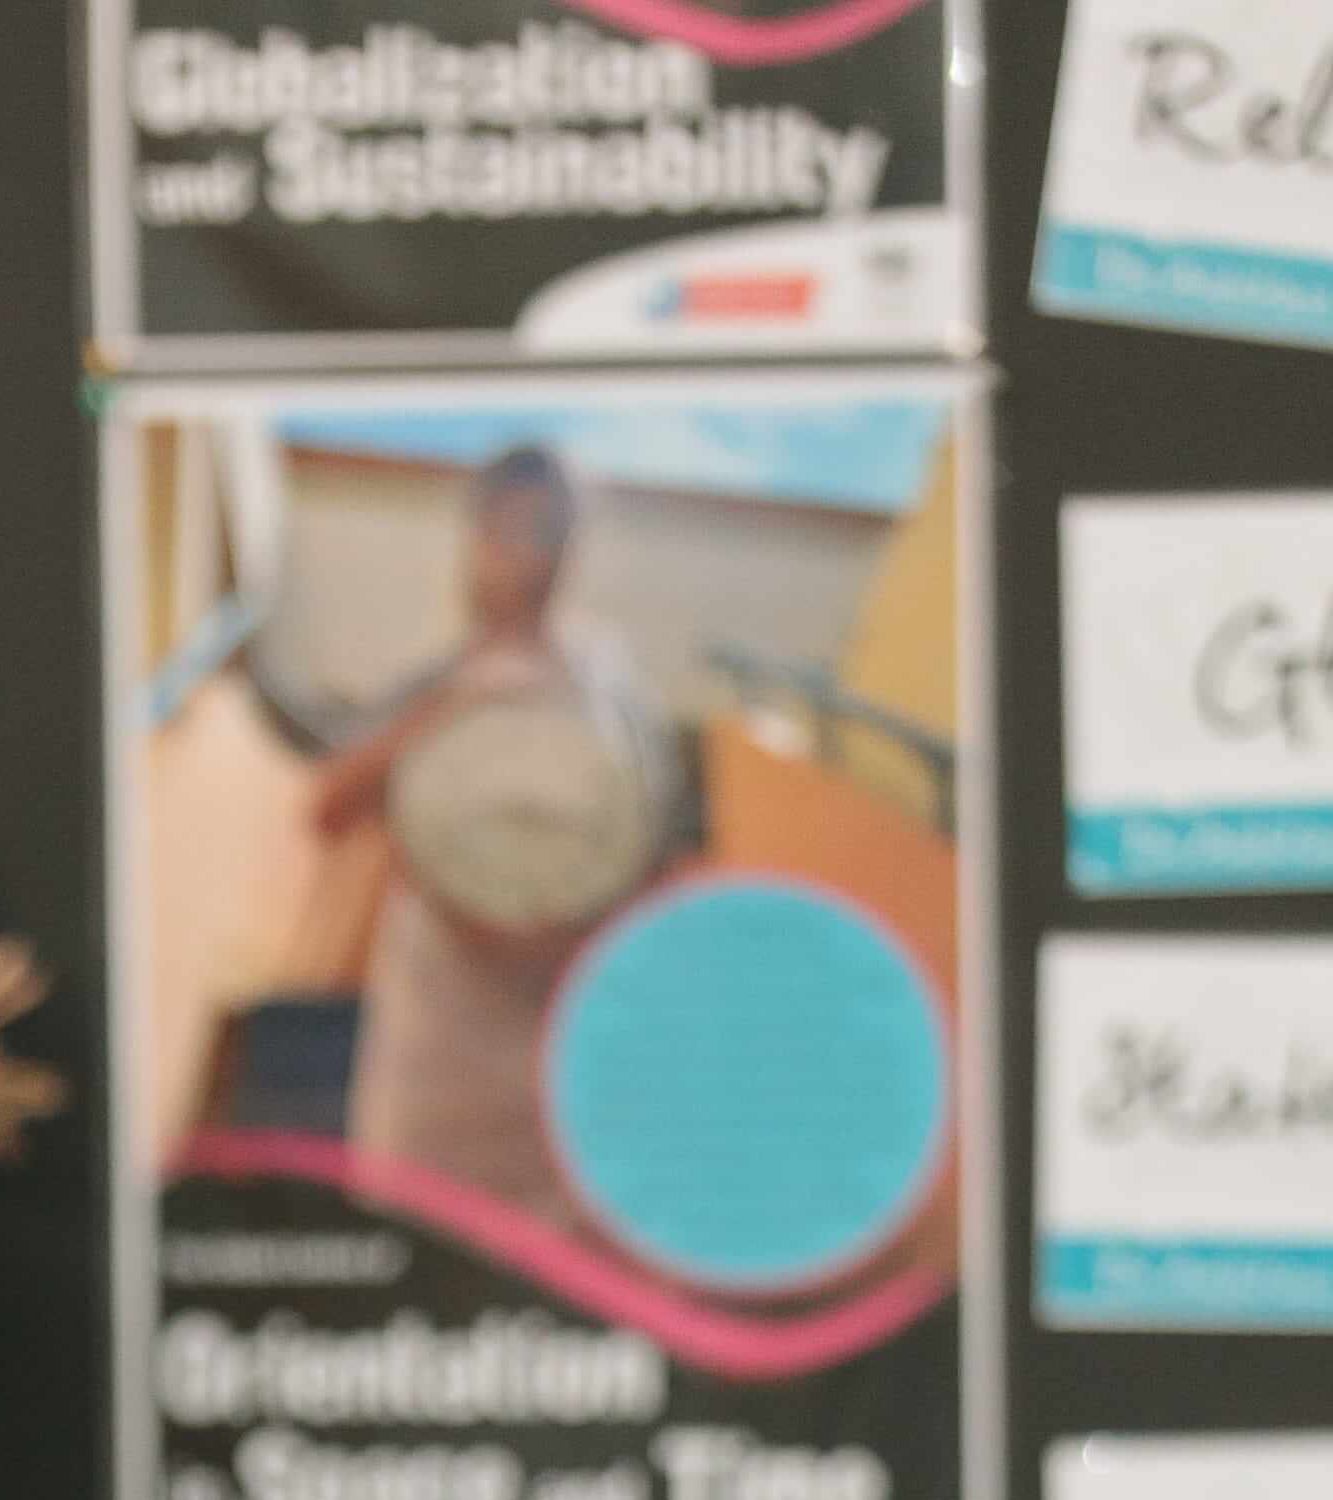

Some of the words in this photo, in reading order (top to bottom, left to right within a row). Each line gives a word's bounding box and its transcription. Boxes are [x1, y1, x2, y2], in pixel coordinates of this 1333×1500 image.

[137, 25, 709, 134] Globalization
[265, 108, 889, 221] Sustainability
[161, 1310, 667, 1425] Orientation
